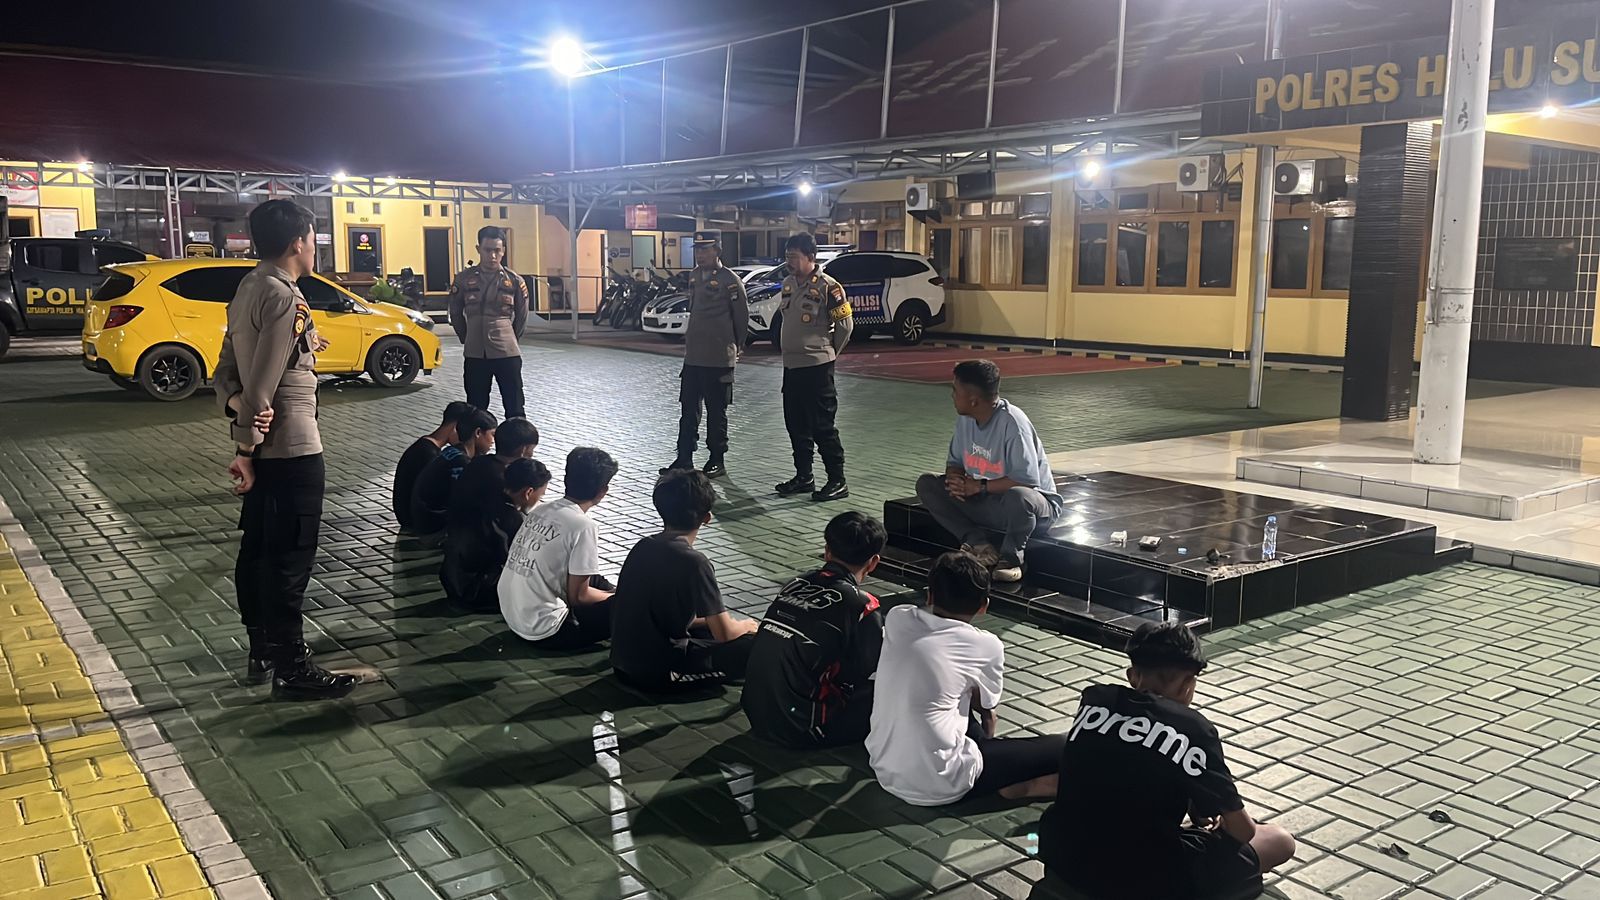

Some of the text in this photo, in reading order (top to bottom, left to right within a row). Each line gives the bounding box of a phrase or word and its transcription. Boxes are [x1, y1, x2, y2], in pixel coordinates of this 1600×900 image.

[1255, 63, 1401, 114] POLRES
[847, 294, 880, 307] POLISI
[532, 523, 561, 542] only
